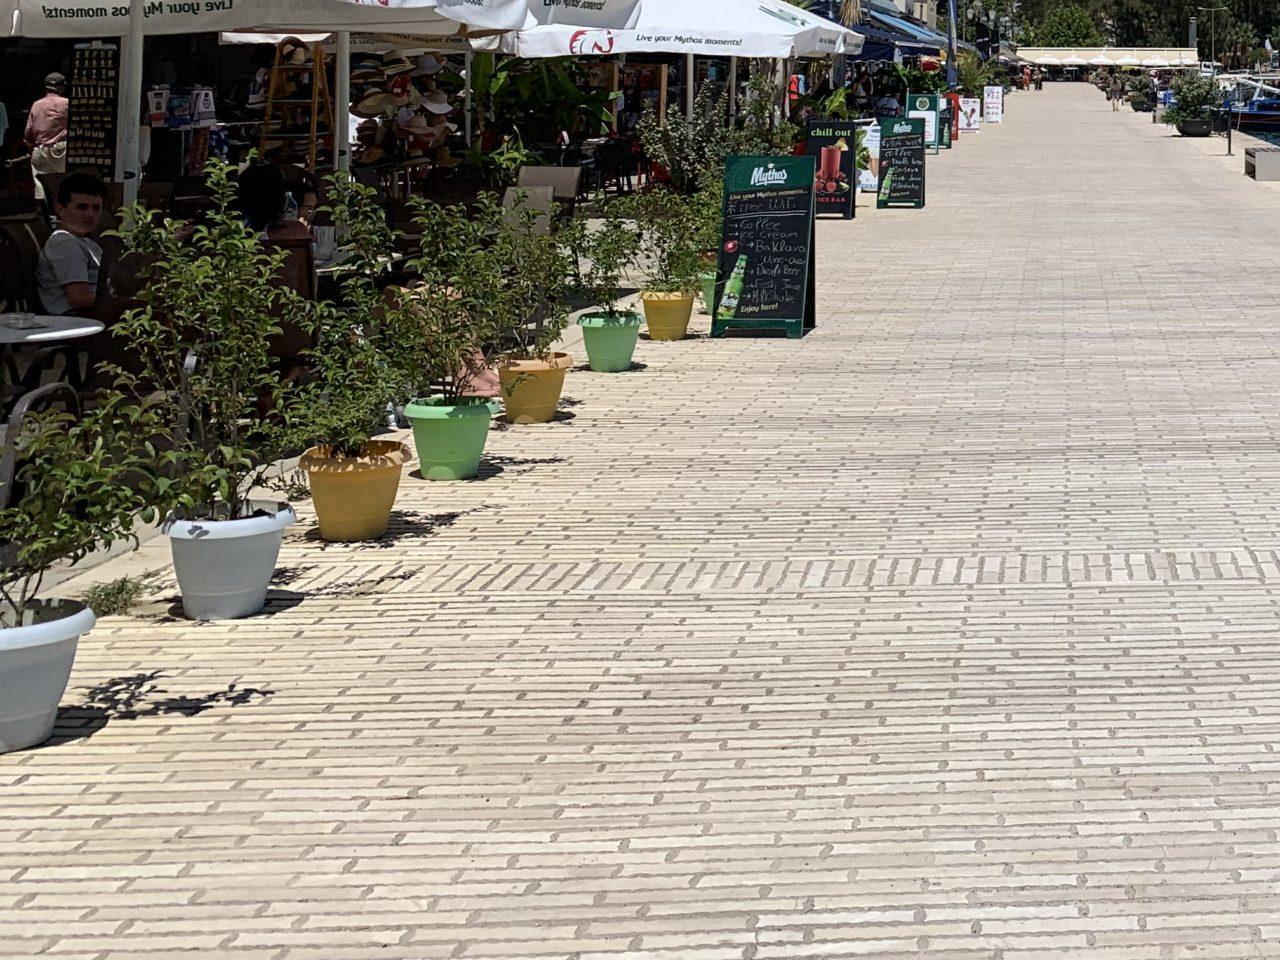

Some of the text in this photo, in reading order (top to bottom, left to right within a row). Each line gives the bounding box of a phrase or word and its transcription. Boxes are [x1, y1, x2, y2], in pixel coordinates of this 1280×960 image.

[636, 34, 742, 46] Live your Mythos moments!
[811, 128, 832, 136] chill
[750, 167, 788, 186] Mythos
[740, 305, 760, 313] Enjoy
